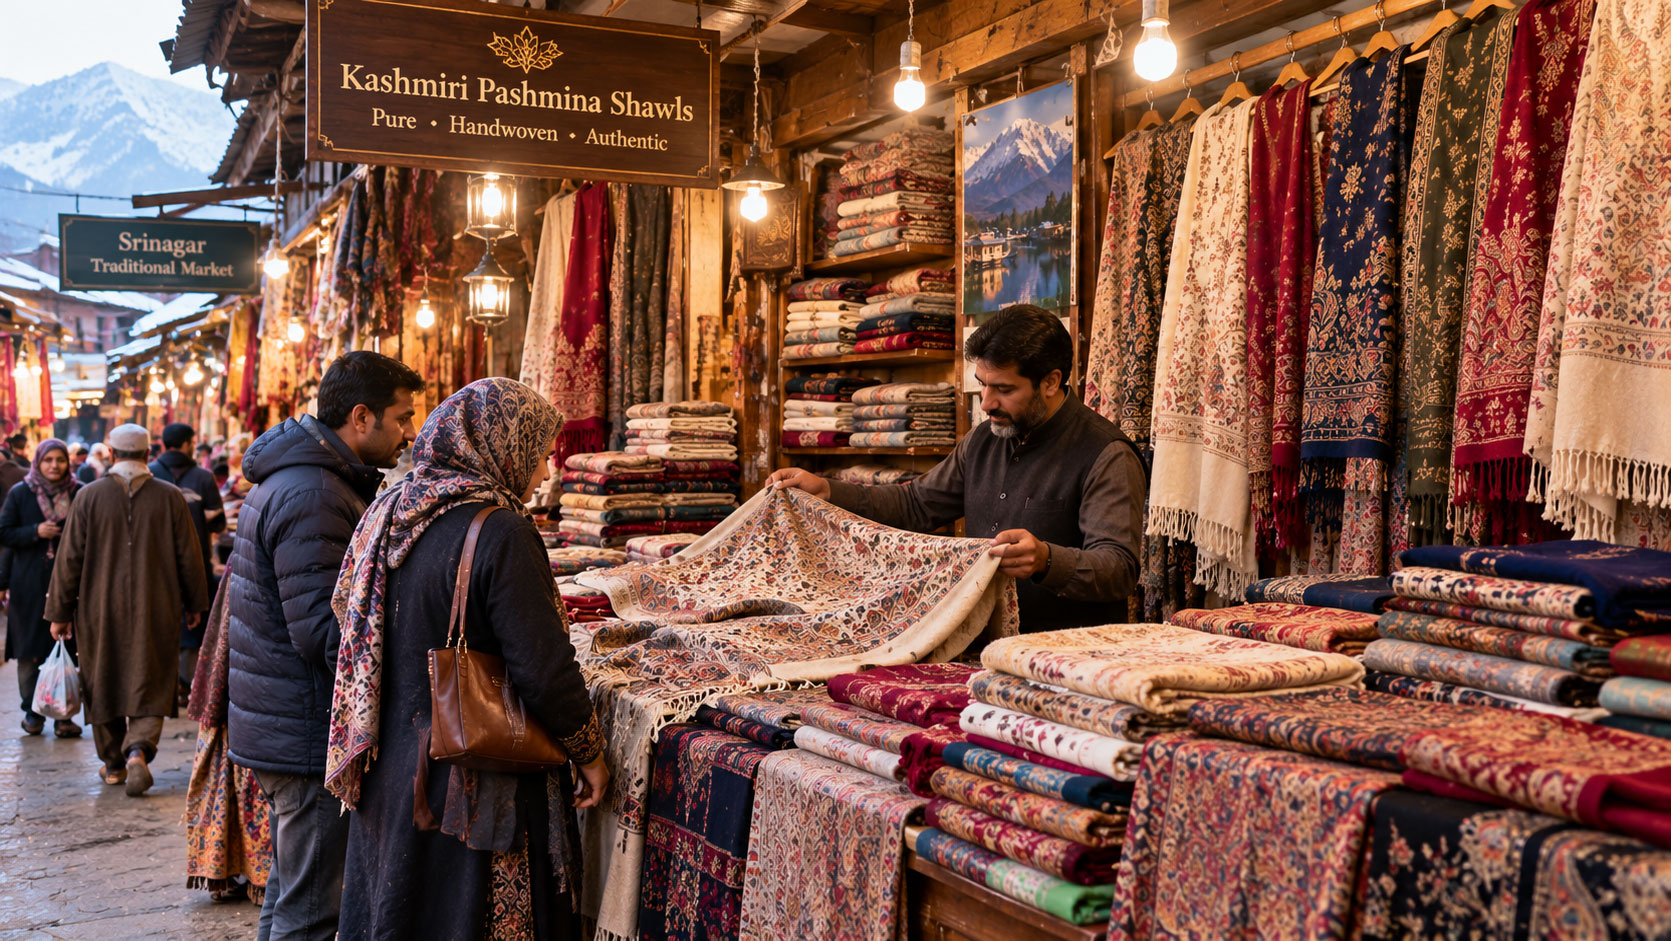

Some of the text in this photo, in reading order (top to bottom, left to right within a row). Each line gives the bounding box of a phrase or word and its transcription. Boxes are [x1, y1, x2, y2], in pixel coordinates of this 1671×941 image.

[340, 63, 694, 122] Kashmiri Pashmina Shawls
[372, 108, 668, 151] Pure Handwoven Authentic
[118, 231, 207, 258] Srinagar
[90, 258, 234, 277] Traditional Market
